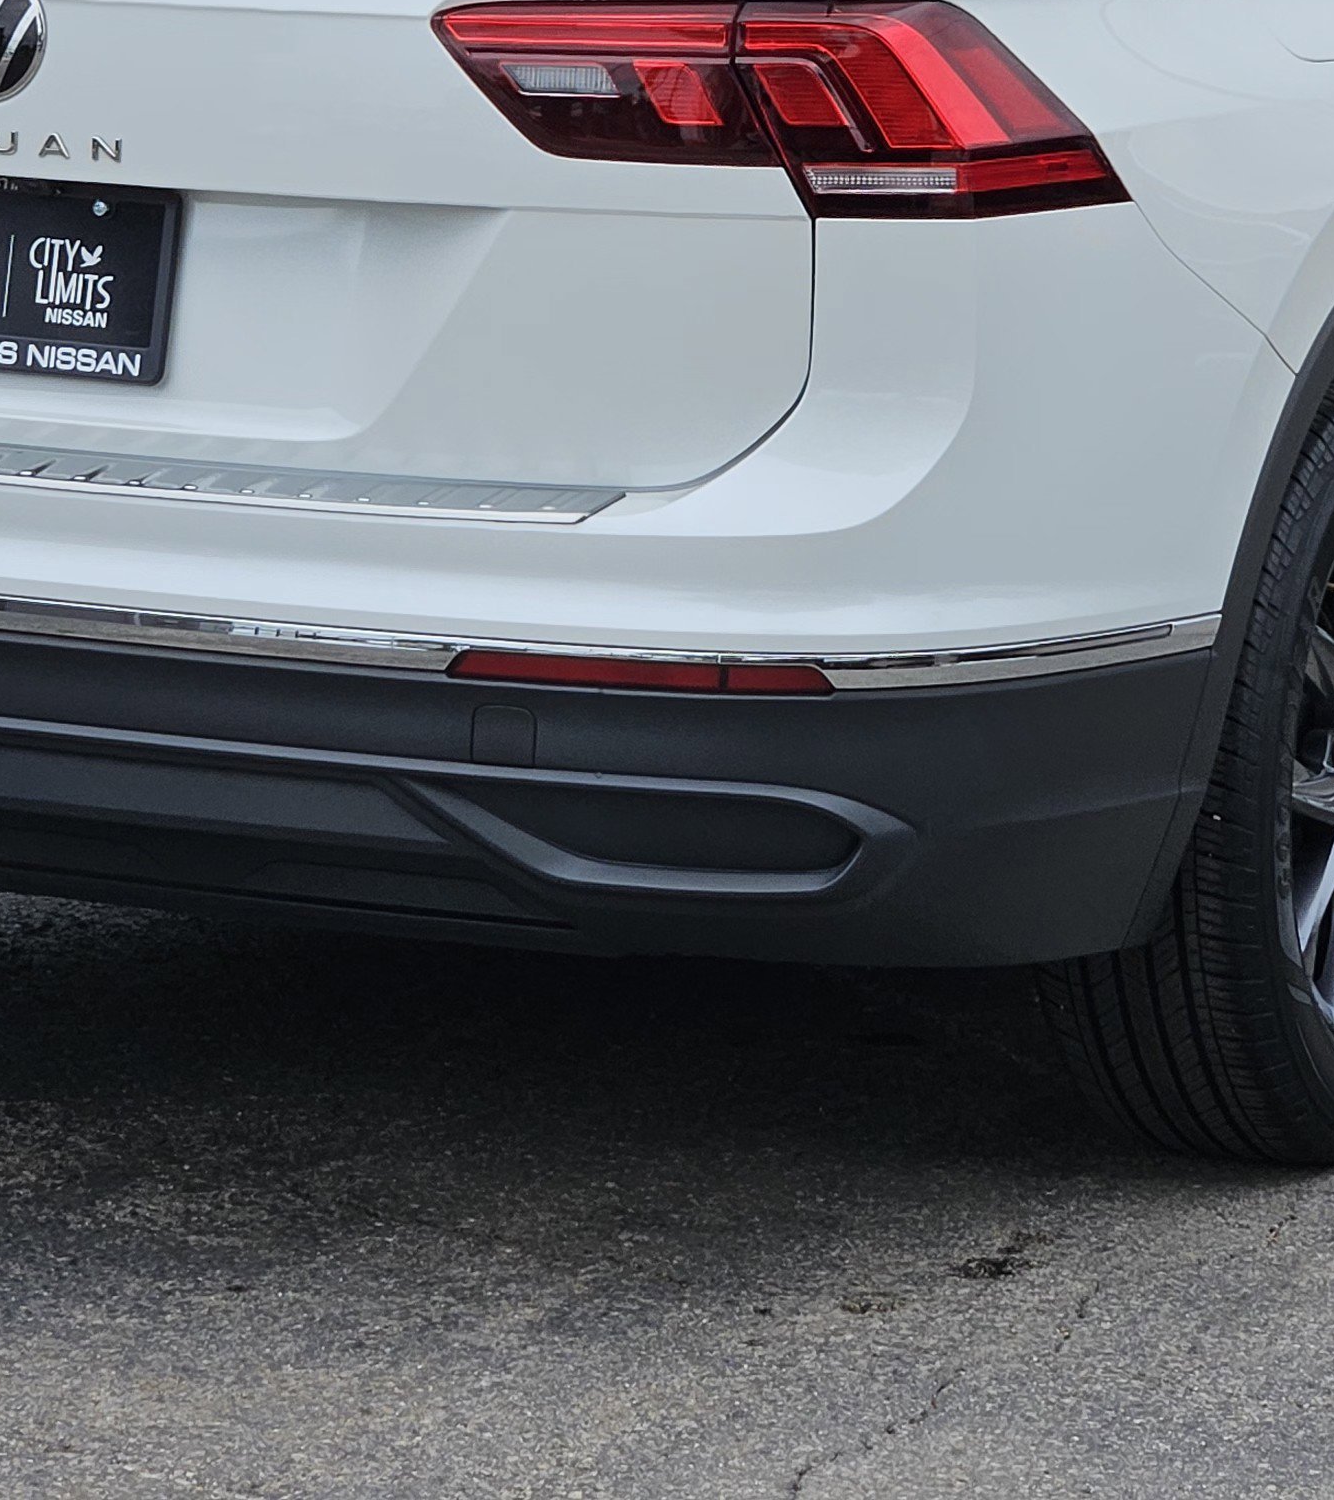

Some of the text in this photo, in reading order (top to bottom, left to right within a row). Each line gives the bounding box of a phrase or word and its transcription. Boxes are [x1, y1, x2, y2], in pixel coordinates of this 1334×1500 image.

[29, 236, 81, 273] CITY
[34, 268, 114, 311] LIMITS
[44, 307, 108, 329] NISSAN
[26, 344, 142, 377] NISSAN
